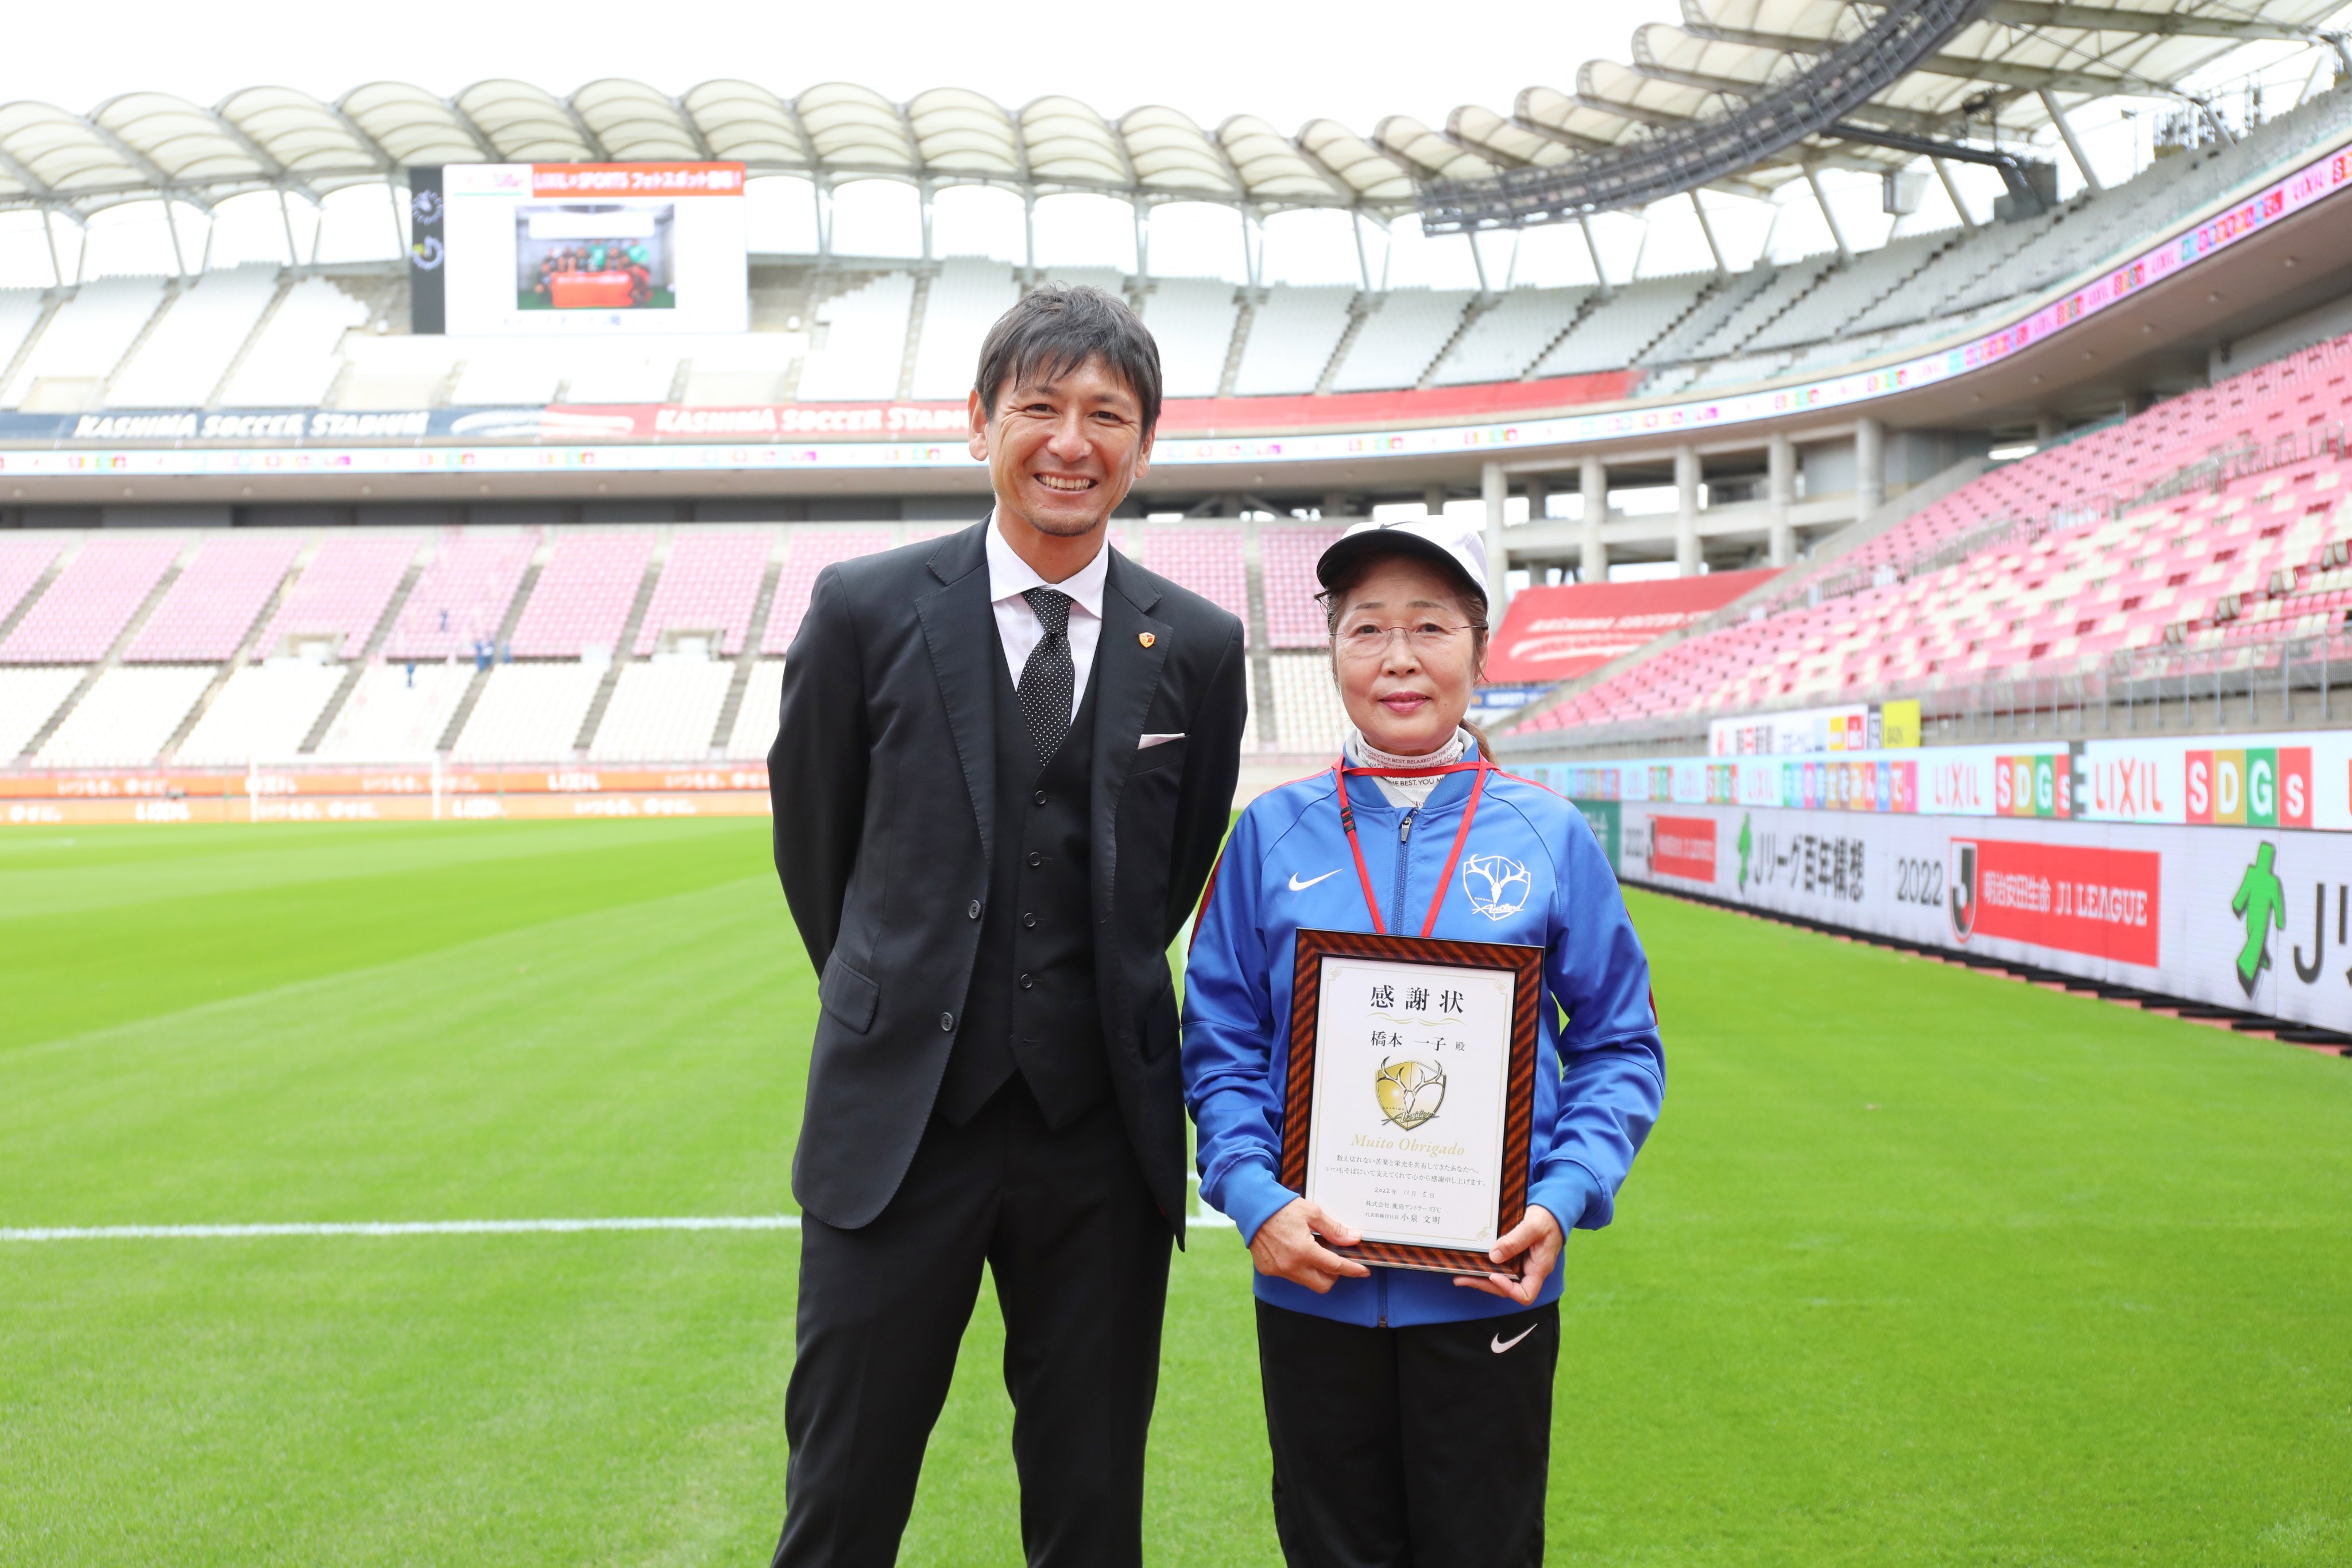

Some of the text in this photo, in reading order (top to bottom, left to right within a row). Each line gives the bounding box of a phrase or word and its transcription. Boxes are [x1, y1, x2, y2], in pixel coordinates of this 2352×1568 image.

[73, 411, 430, 438] KASHIMA SOCCER STADIUM
[655, 407, 969, 433] KASHIMA SOCCER STADI
[1438, 749, 1446, 757] THE
[1748, 768, 1774, 799] LIXIL
[1935, 760, 2069, 810] LIXIL SDGs
[2095, 757, 2304, 818] LIXIL SDGs
[1754, 833, 1866, 902] Jリーグ百年構想
[1897, 858, 1943, 907] 2022
[1983, 872, 2148, 926] 明治安田生命 J1 LEAGUE
[1371, 985, 1464, 1013] 感謝状
[1371, 1031, 1465, 1051] 橋本 一子 殿
[1351, 1134, 1464, 1158] Muito Obrigado
[1326, 1166, 1486, 1187] いつもそばにいて支えてくれて心から感謝申し上げます。
[1337, 1154, 1479, 1174] 数え切れない苦楽と栄光を共有してきたあなたへ。
[1366, 1200, 1442, 1213] 株式会社 鹿島アントラーズFC
[1401, 1213, 1418, 1222] 小泉
[1423, 1215, 1440, 1225] 文明
